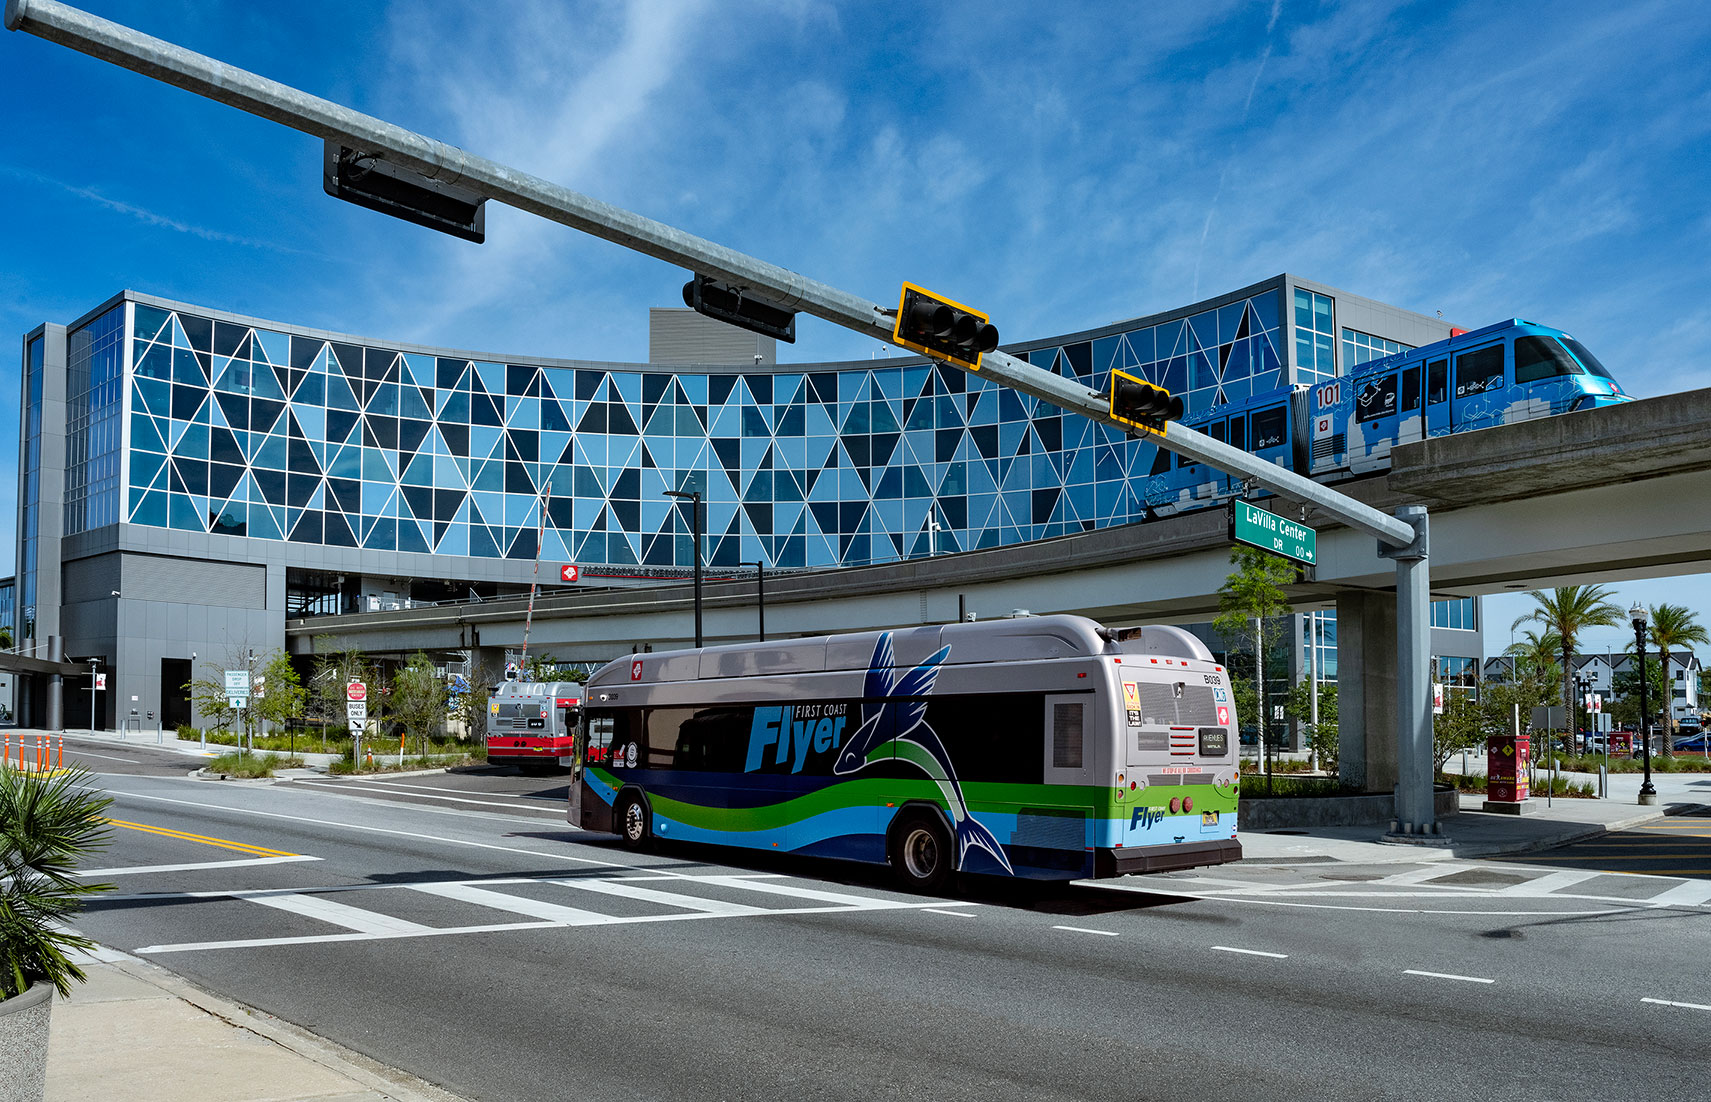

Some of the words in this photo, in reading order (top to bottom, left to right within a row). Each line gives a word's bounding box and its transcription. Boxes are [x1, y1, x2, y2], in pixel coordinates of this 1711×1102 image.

[1317, 382, 1340, 409] 101
[1246, 506, 1276, 532] LaVilla
[1279, 520, 1307, 542] Center
[1273, 537, 1283, 551] DR
[1203, 674, 1221, 685] B039
[796, 705, 821, 718] FIRST
[823, 703, 847, 716] COAST
[744, 705, 847, 774] Flyer
[1129, 806, 1165, 831] Flyer
